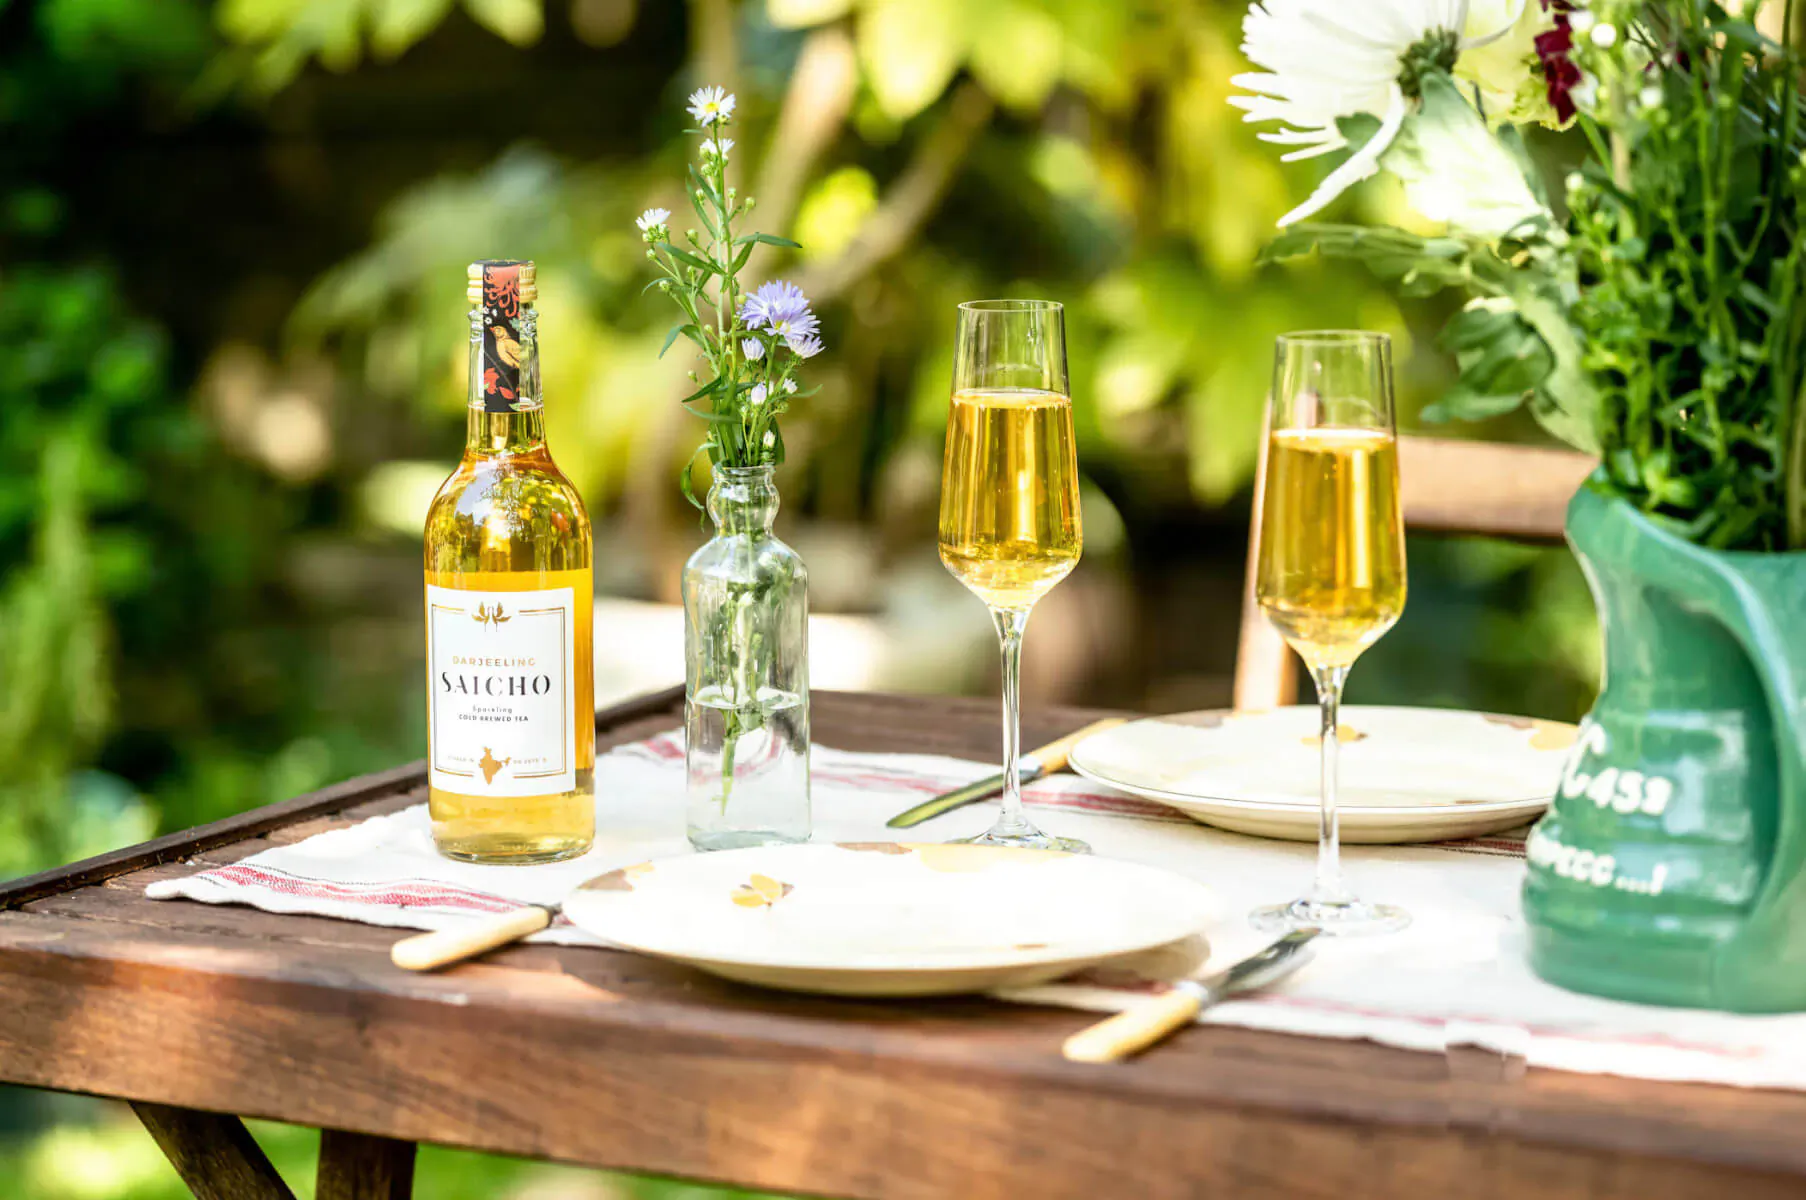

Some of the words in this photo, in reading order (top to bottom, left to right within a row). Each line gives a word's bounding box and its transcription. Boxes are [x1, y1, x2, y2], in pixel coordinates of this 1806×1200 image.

[452, 655, 536, 668] DARJEELING
[441, 671, 551, 696] SAICHO
[458, 713, 477, 721] COLD
